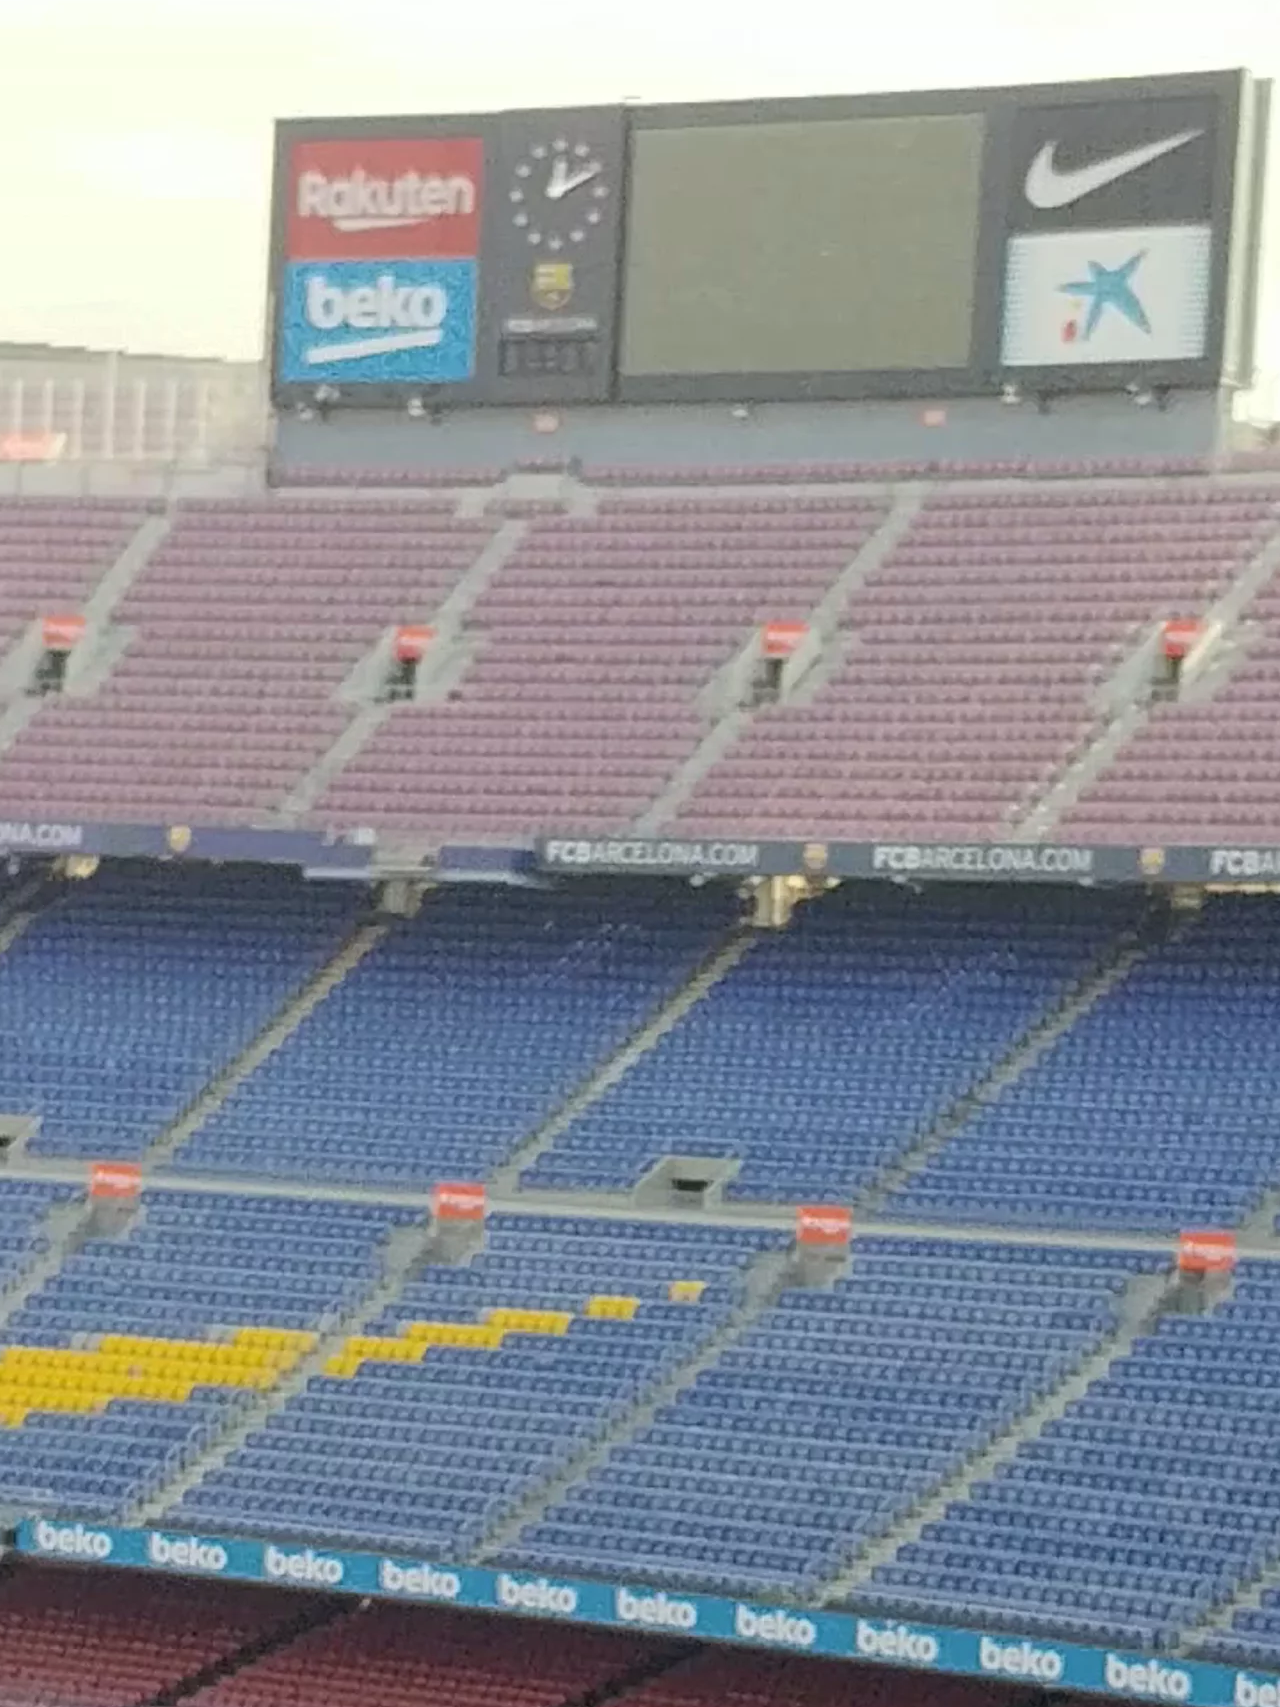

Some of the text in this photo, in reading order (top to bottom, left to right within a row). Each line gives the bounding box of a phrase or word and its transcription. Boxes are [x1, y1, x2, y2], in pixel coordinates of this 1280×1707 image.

[297, 170, 475, 216] Rakuten
[305, 275, 448, 329] beko
[547, 840, 759, 866] FCBARCELONA.COM
[873, 845, 1093, 871] FCBARCELONA.COM
[38, 1520, 111, 1558] beko
[149, 1532, 227, 1570] beko
[265, 1545, 343, 1584] beko
[380, 1558, 460, 1597] beko
[497, 1573, 577, 1613] beko
[616, 1588, 697, 1628] beko
[736, 1603, 815, 1645] beko
[856, 1620, 938, 1662] beko
[980, 1636, 1064, 1680] beko
[1106, 1652, 1191, 1700] beko
